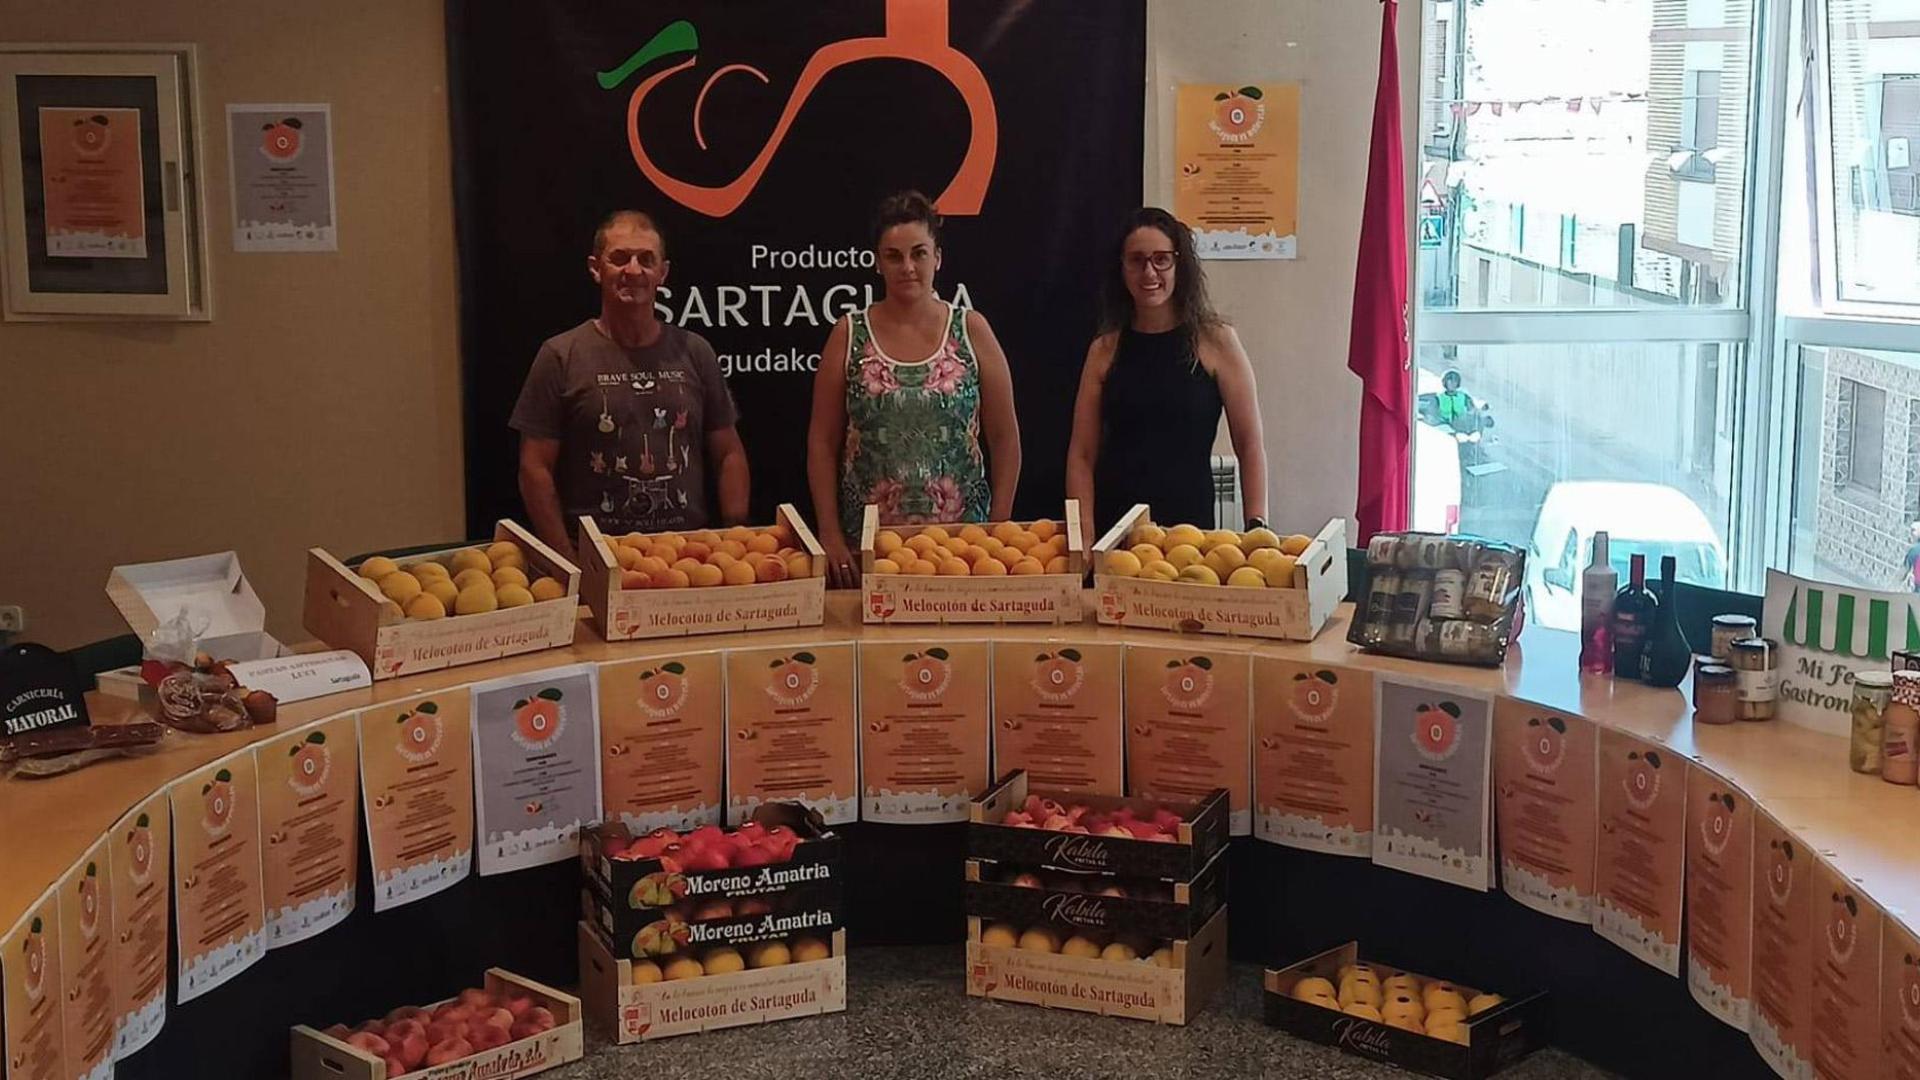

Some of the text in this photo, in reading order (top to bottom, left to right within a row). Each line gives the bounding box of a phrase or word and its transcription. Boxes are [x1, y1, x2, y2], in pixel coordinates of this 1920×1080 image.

[751, 244, 876, 269] Producto
[654, 283, 976, 327] SARTAGA
[597, 371, 686, 382] BRAVE SOUL MUSIC
[717, 348, 822, 378] gudako
[717, 609, 731, 622] de
[735, 603, 798, 621] Sartaguda
[971, 598, 985, 612] de
[990, 597, 1054, 615] Sartaguda
[1198, 608, 1213, 622] de
[1216, 610, 1280, 628] Sartaguda
[475, 636, 489, 651] de
[492, 626, 550, 648] Sartaguda
[1796, 657, 1854, 686] Mi Fe
[1780, 679, 1852, 713] Gastron
[5, 704, 78, 735] MAYORAL
[1044, 835, 1108, 867] Kabila
[685, 863, 830, 895] Moreno Amatria
[726, 885, 786, 897] FRUTAS
[1042, 894, 1105, 925] Kabila
[688, 910, 833, 943] Moreno Amatria
[729, 932, 789, 944] FRUTAS
[731, 996, 746, 1013] de
[750, 988, 816, 1011] Sartaguda
[1072, 983, 1087, 999] de
[1090, 986, 1155, 1008] Sartaguda
[1332, 1017, 1392, 1051] Kabila
